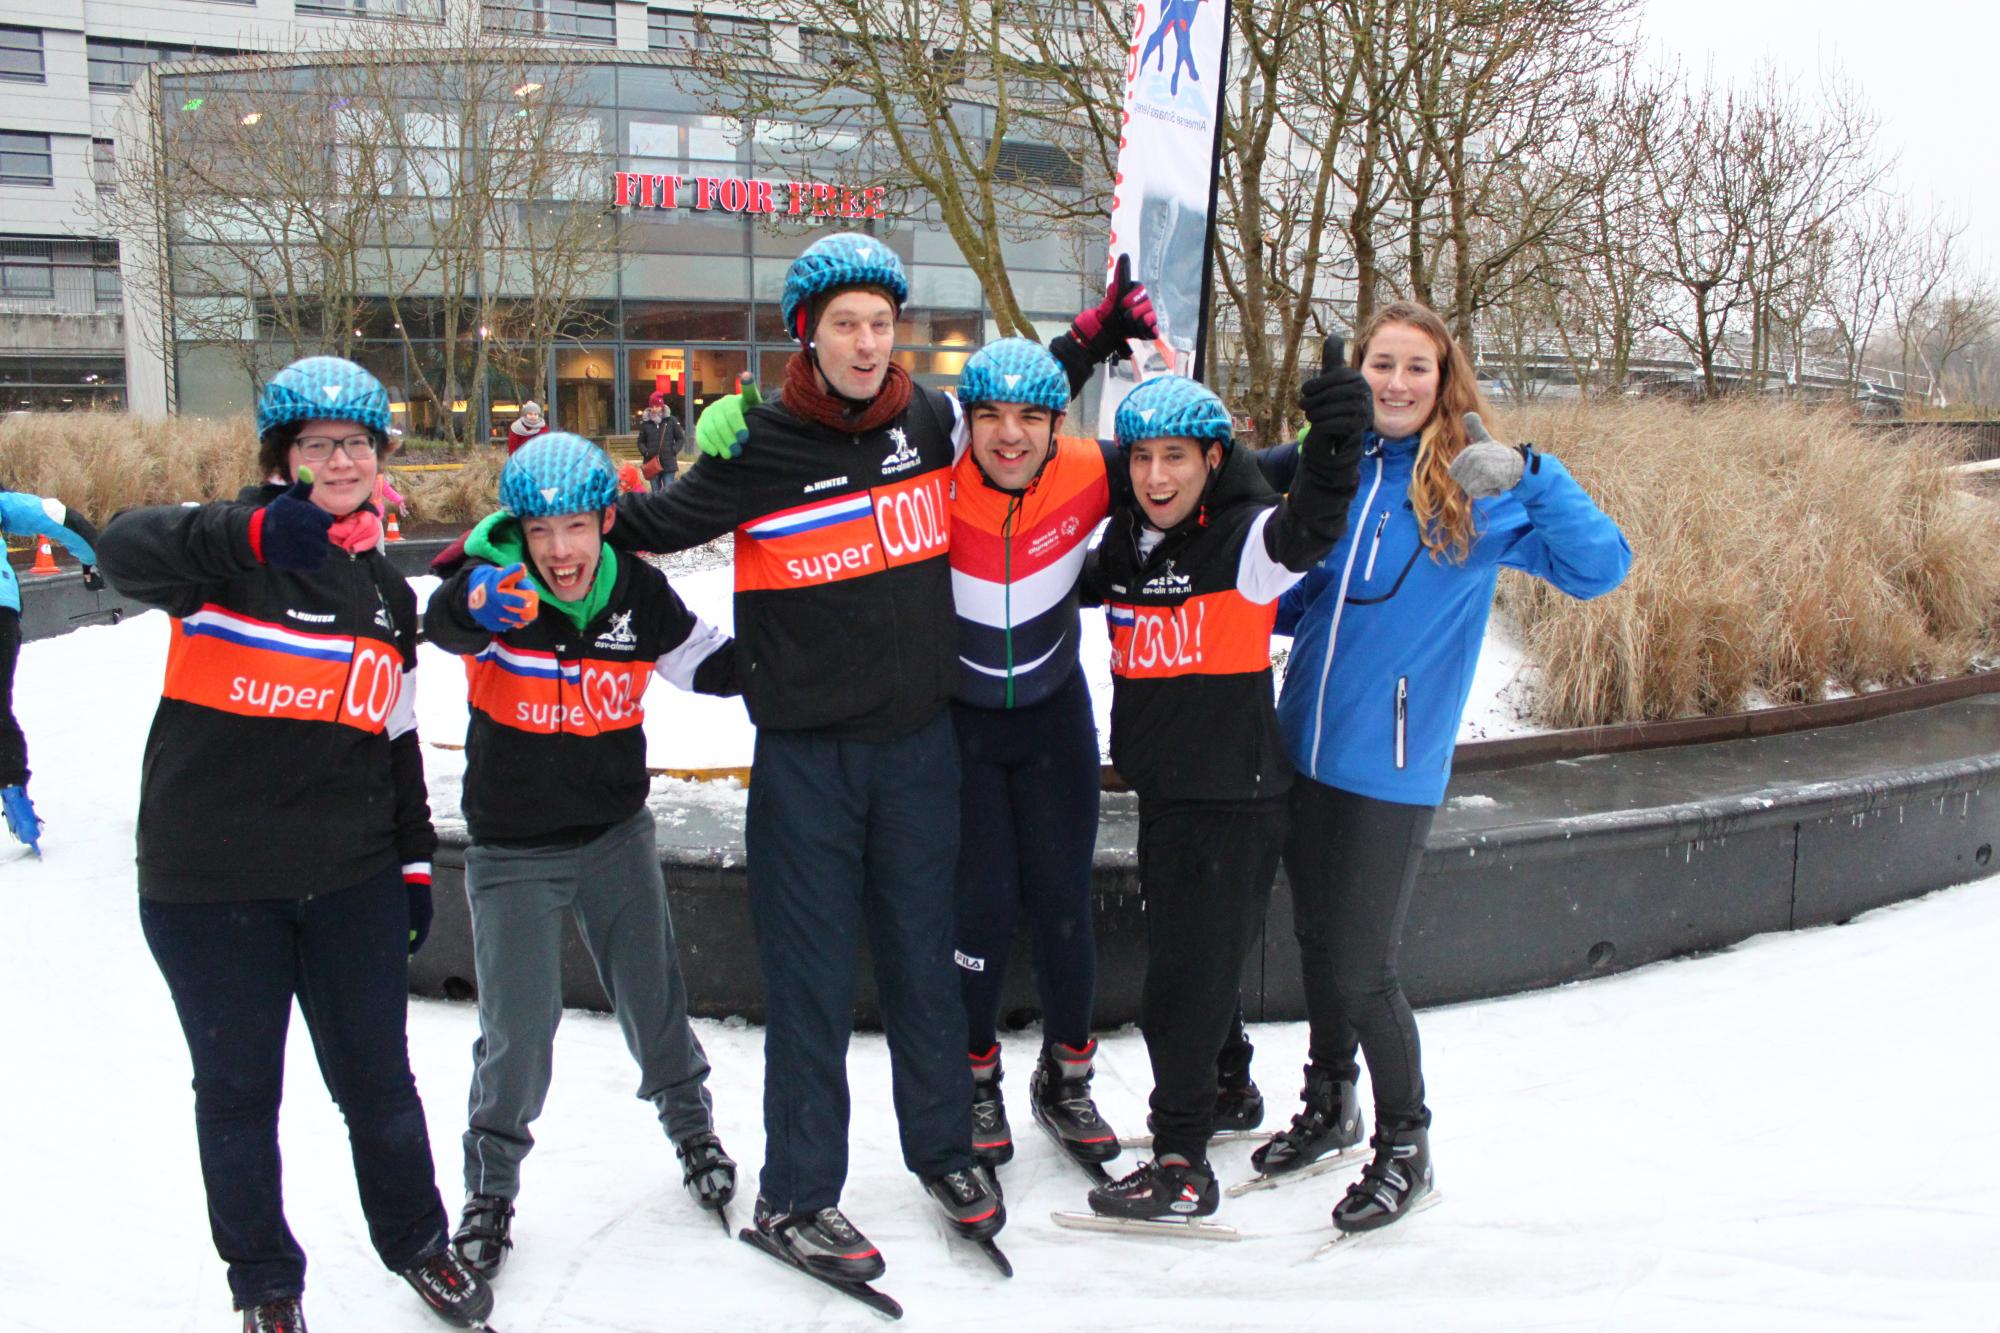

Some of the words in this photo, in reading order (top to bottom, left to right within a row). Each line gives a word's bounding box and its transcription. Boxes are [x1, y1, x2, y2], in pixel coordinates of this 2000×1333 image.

[614, 172, 683, 209] FIT
[696, 177, 776, 213] FOR
[788, 182, 885, 219] FREE
[665, 359, 682, 370] FOR
[814, 476, 848, 490] HUNTER
[786, 542, 873, 580] super
[876, 478, 947, 557] COOL!
[230, 676, 334, 714] super
[516, 700, 585, 729] supe
